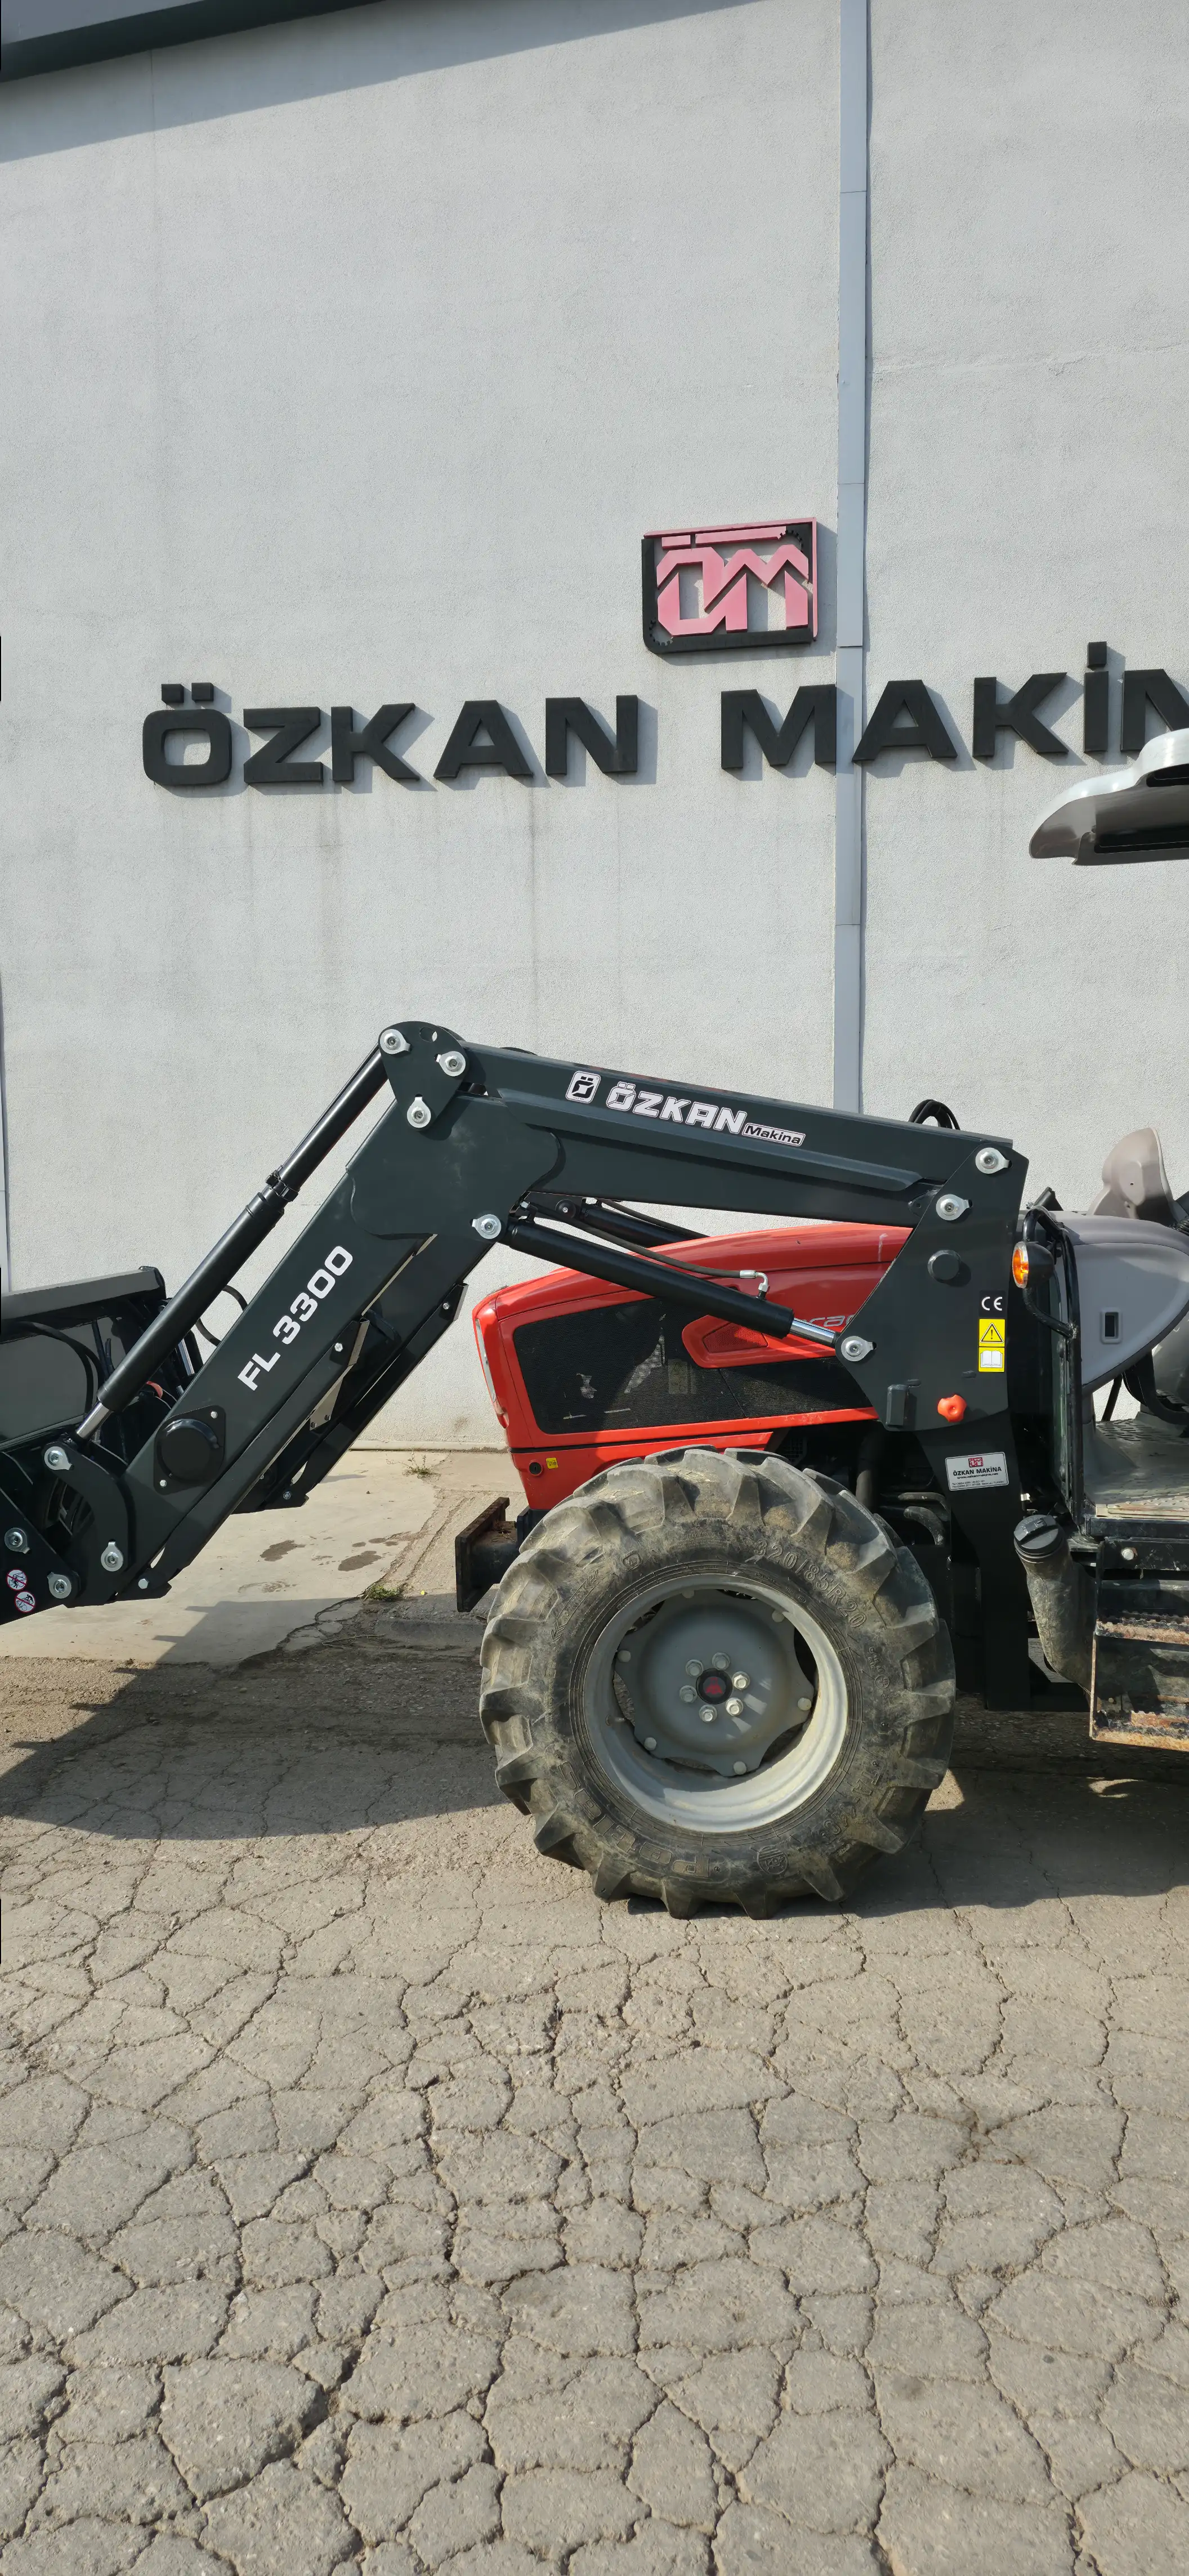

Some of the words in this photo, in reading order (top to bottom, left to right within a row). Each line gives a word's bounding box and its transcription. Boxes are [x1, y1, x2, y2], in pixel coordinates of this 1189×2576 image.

[142, 682, 638, 786] ÖZKAN
[606, 1081, 747, 1134] ÖZKAN
[745, 1125, 801, 1145] Makina
[238, 1352, 280, 1390] FL
[273, 1246, 353, 1344] 3300
[981, 1296, 1003, 1311] CE
